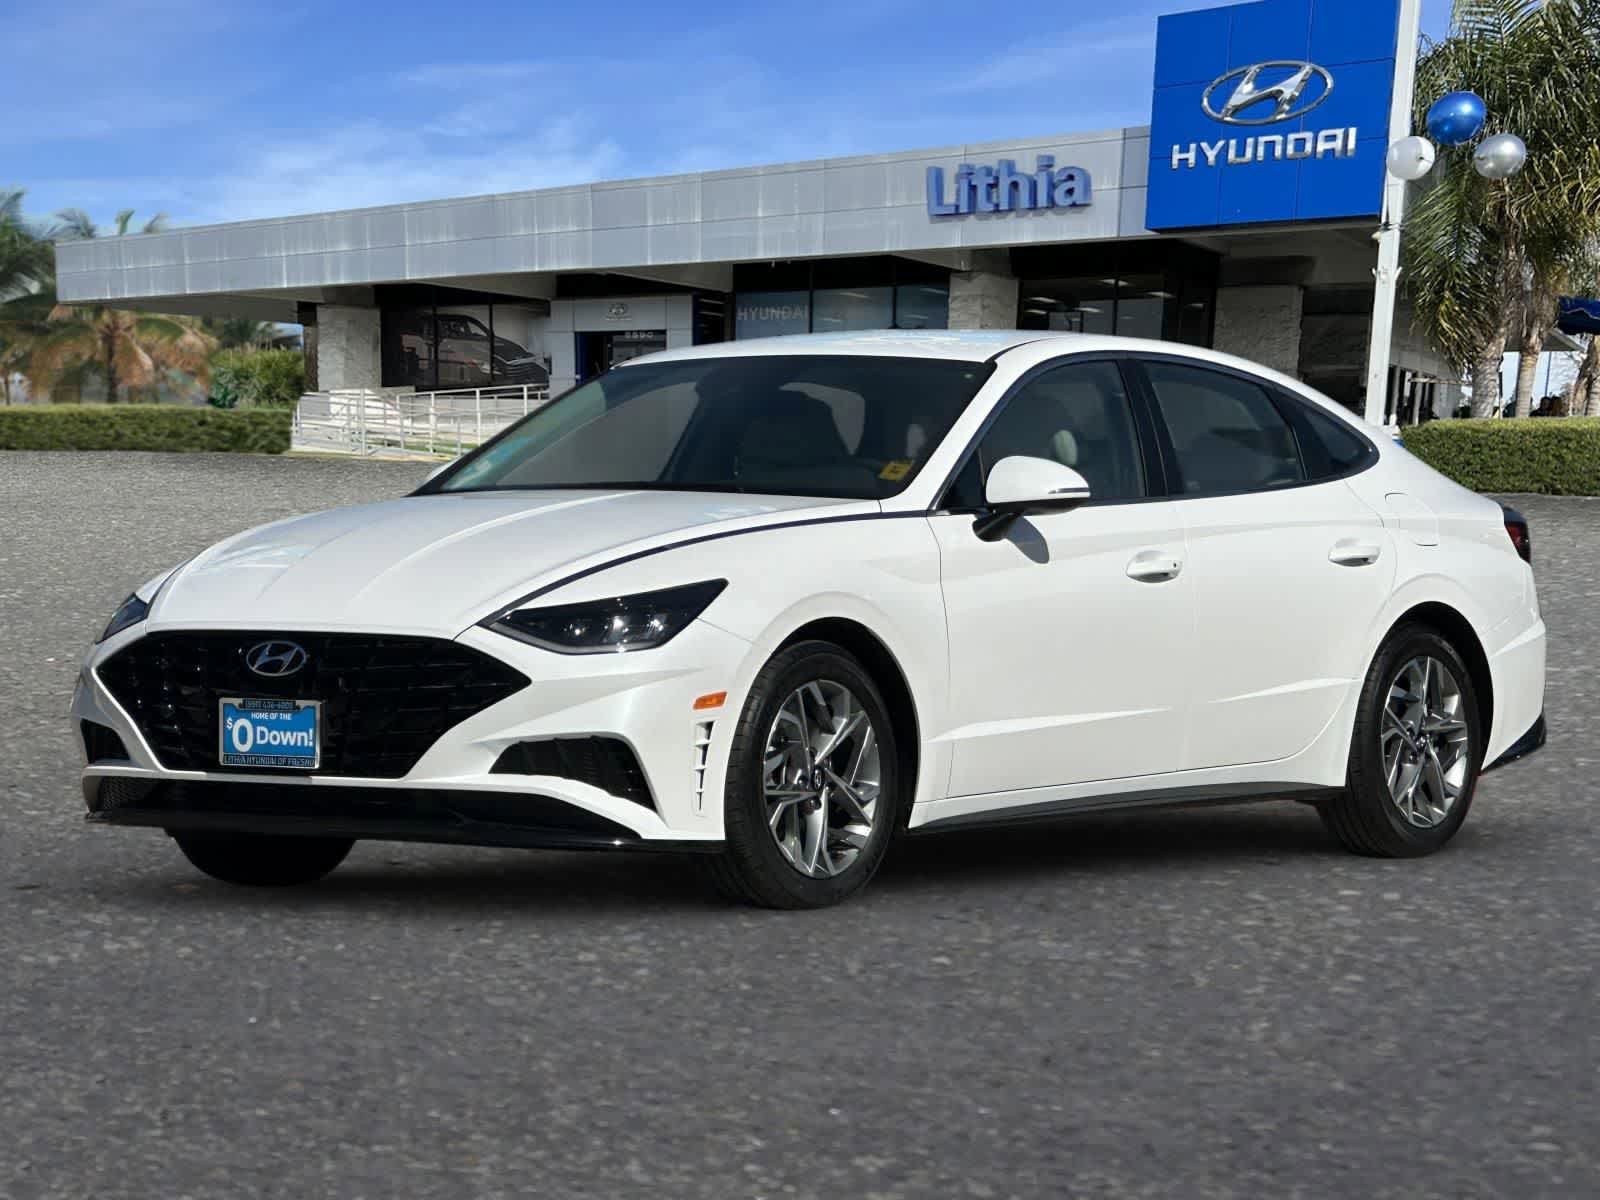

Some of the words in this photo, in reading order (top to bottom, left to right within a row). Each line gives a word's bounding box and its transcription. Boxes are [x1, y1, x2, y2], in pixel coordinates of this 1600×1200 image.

[1171, 127, 1357, 170] HYUNDAI
[926, 155, 1092, 217] Lithia
[736, 304, 808, 320] HYUNDAI
[251, 712, 269, 720] HOME
[269, 712, 278, 720] OF
[279, 712, 293, 721] THE
[256, 726, 314, 747] Down!
